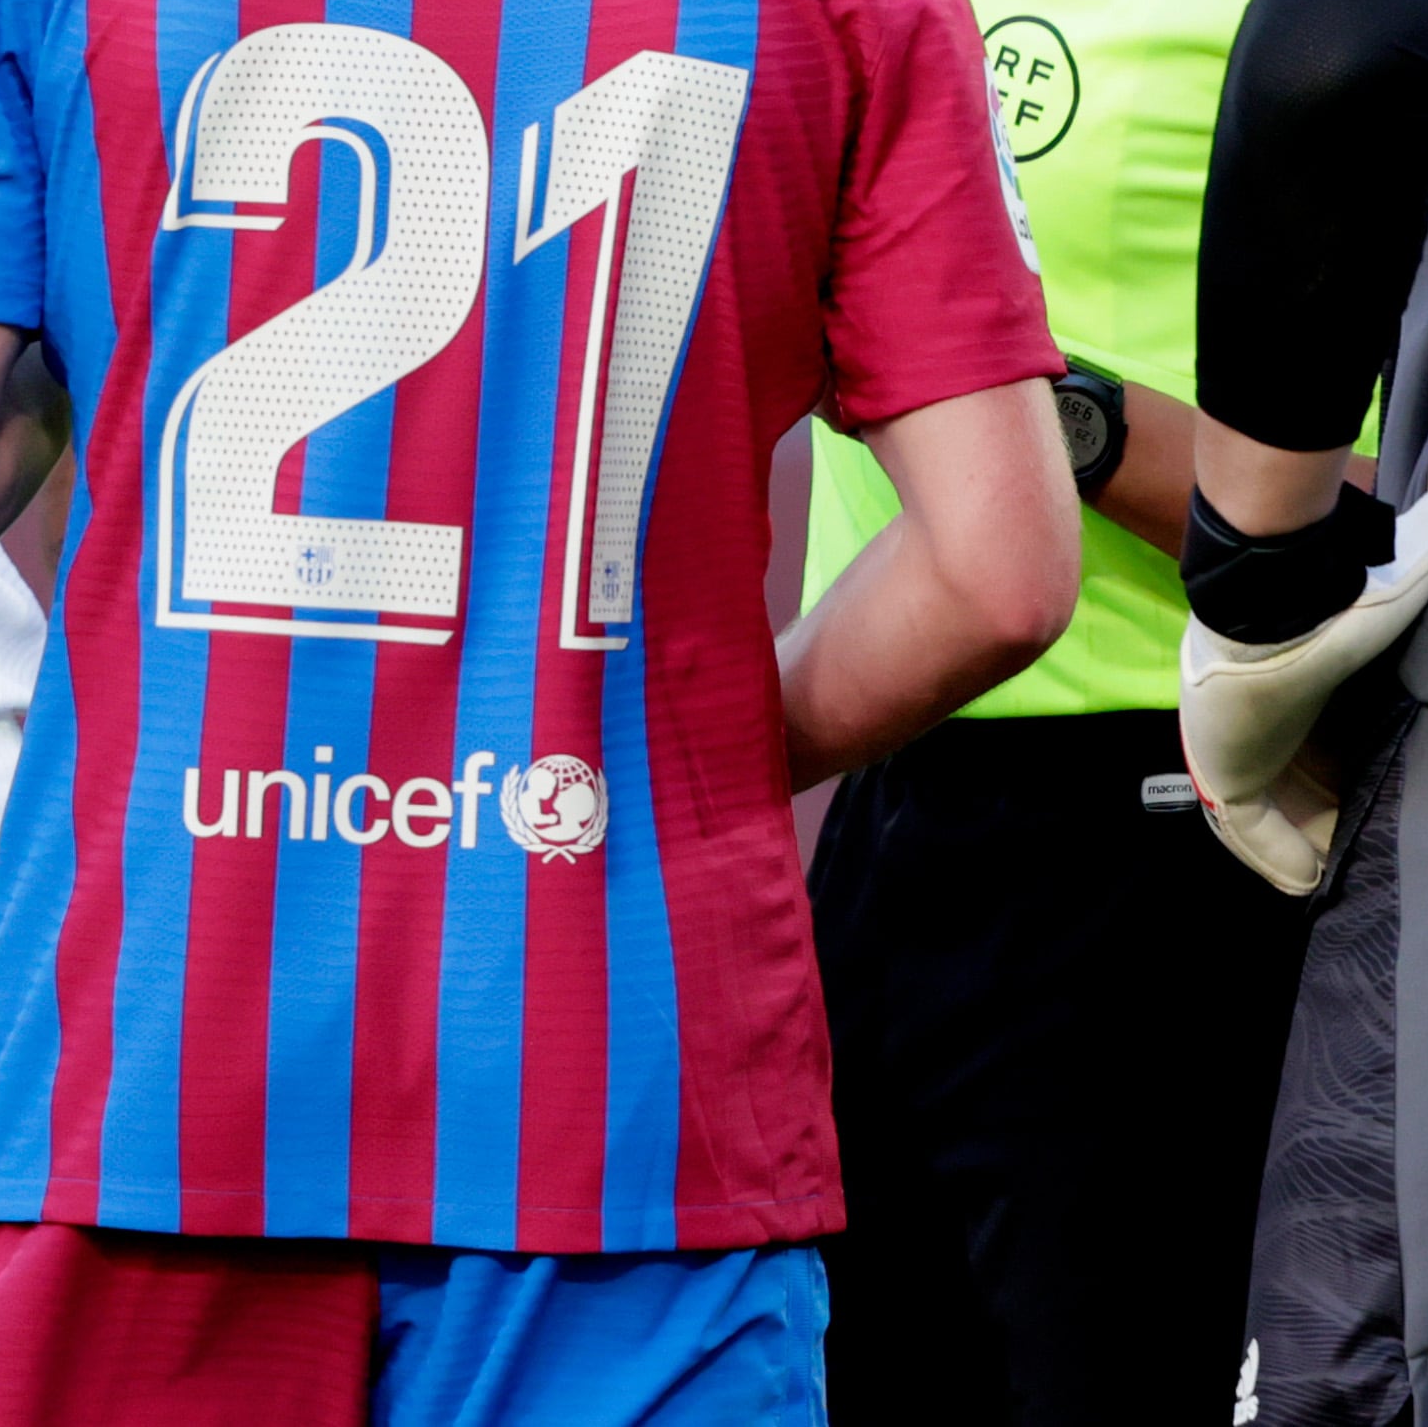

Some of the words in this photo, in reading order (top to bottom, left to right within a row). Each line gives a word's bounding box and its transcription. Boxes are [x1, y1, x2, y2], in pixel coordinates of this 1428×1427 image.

[155, 22, 750, 650] 21
[182, 745, 496, 849] unicef
[1148, 783, 1193, 796] macron
